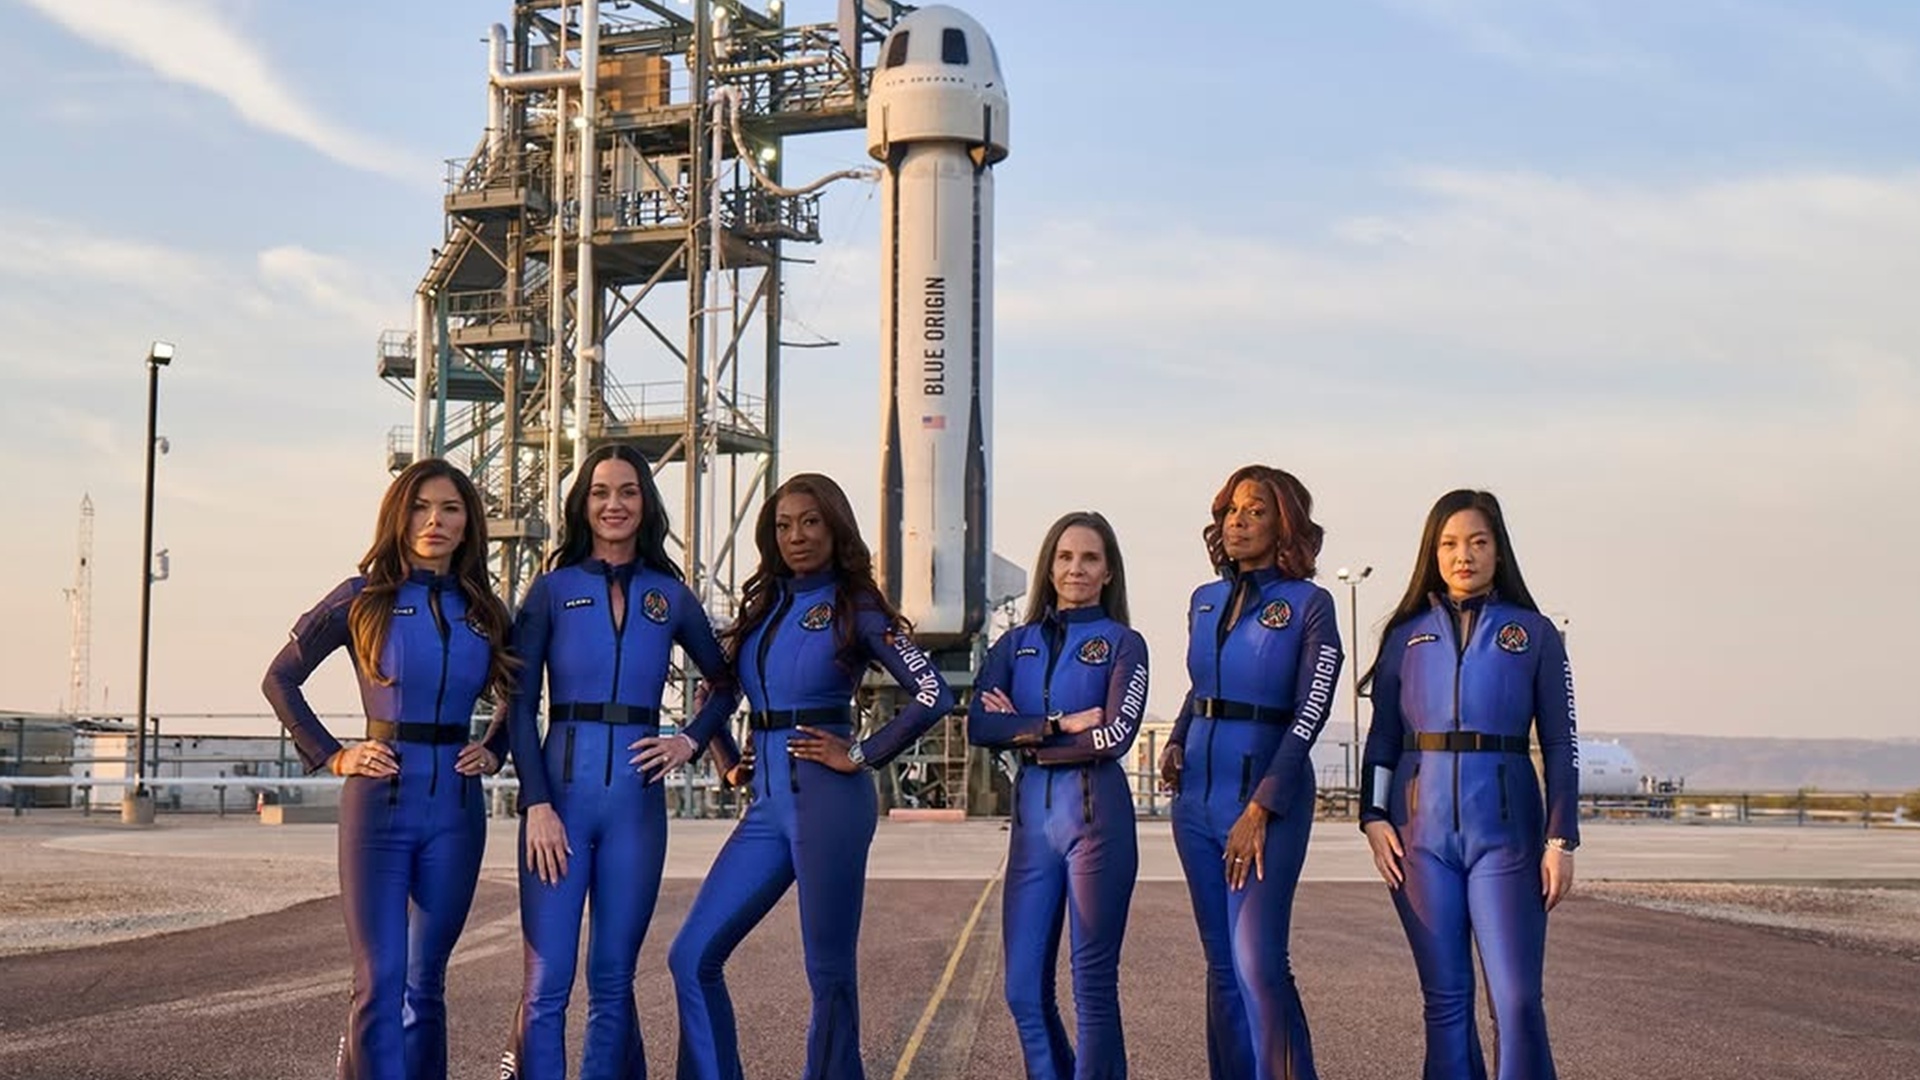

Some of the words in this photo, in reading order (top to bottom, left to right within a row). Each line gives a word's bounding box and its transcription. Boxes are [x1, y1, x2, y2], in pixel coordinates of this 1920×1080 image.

[924, 277, 944, 341] ORIGIN
[924, 348, 944, 395] BLUE
[1309, 644, 1338, 703] ORIGIN
[1092, 716, 1133, 750] BLUE
[1121, 663, 1147, 719] ORIGIN
